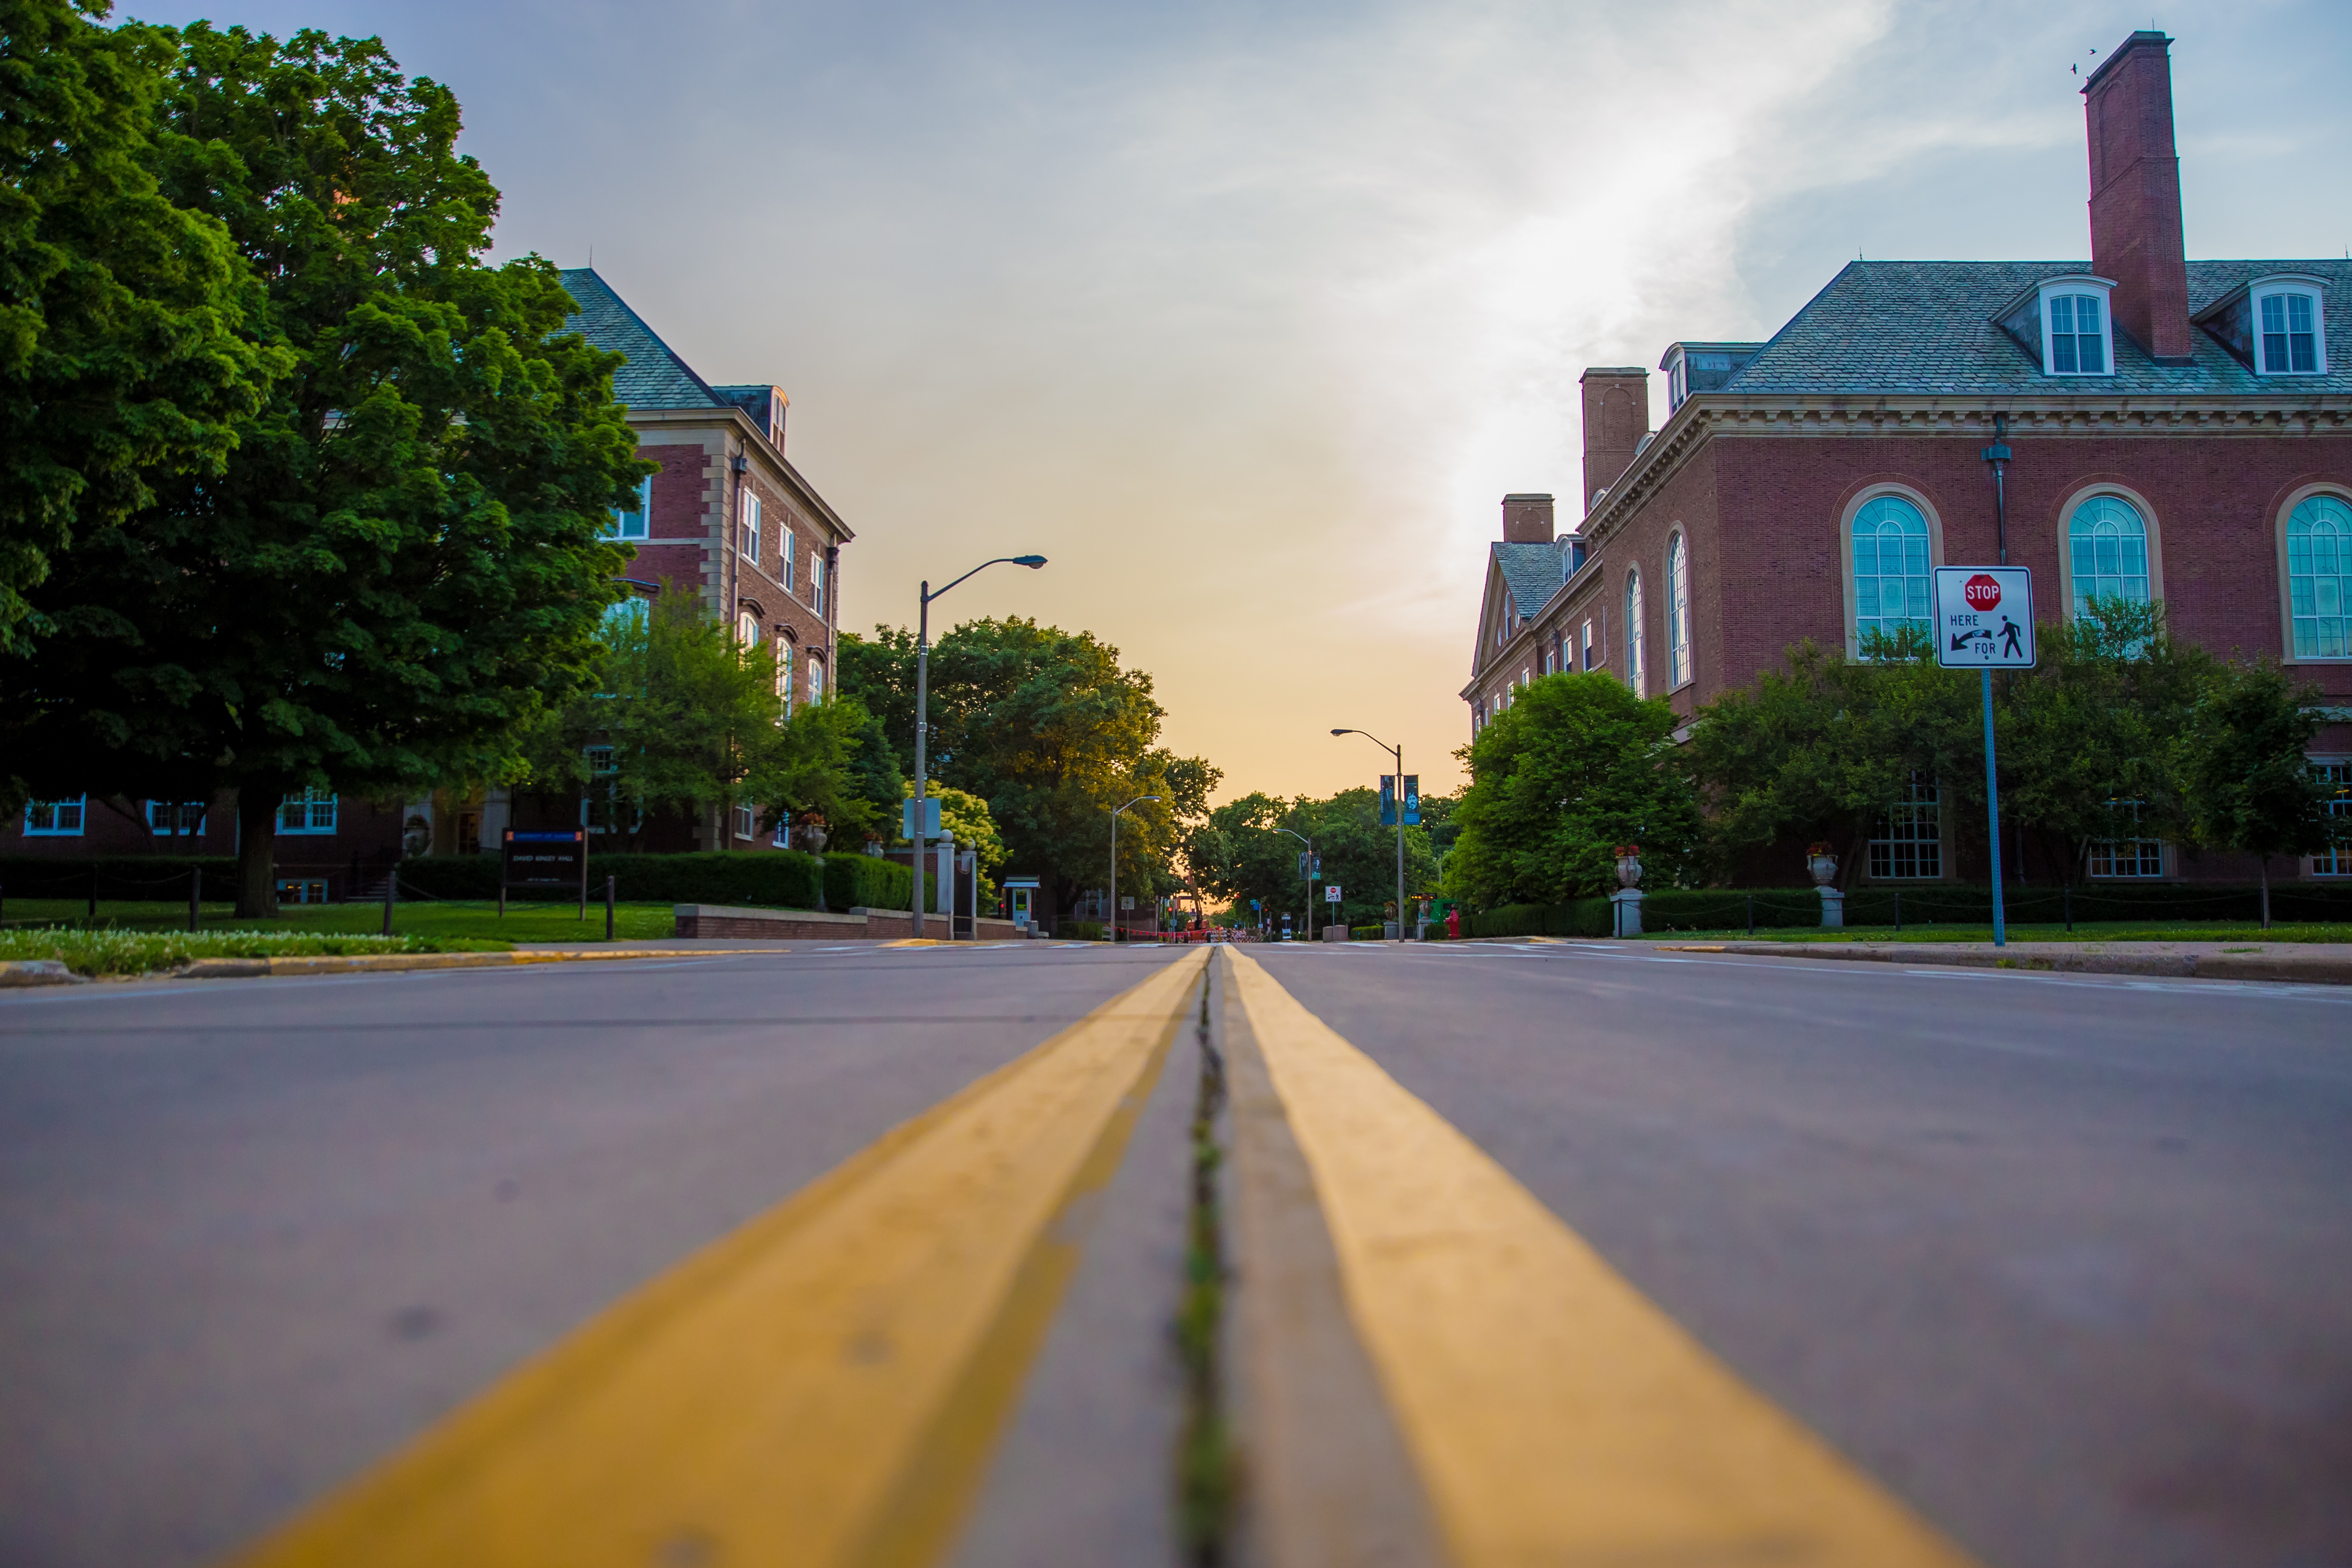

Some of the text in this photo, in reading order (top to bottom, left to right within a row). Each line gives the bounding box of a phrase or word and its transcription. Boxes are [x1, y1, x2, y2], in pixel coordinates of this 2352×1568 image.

[1967, 586, 1999, 600] STOP
[1950, 615, 1979, 626] HERE
[1975, 643, 1996, 654] FOR
